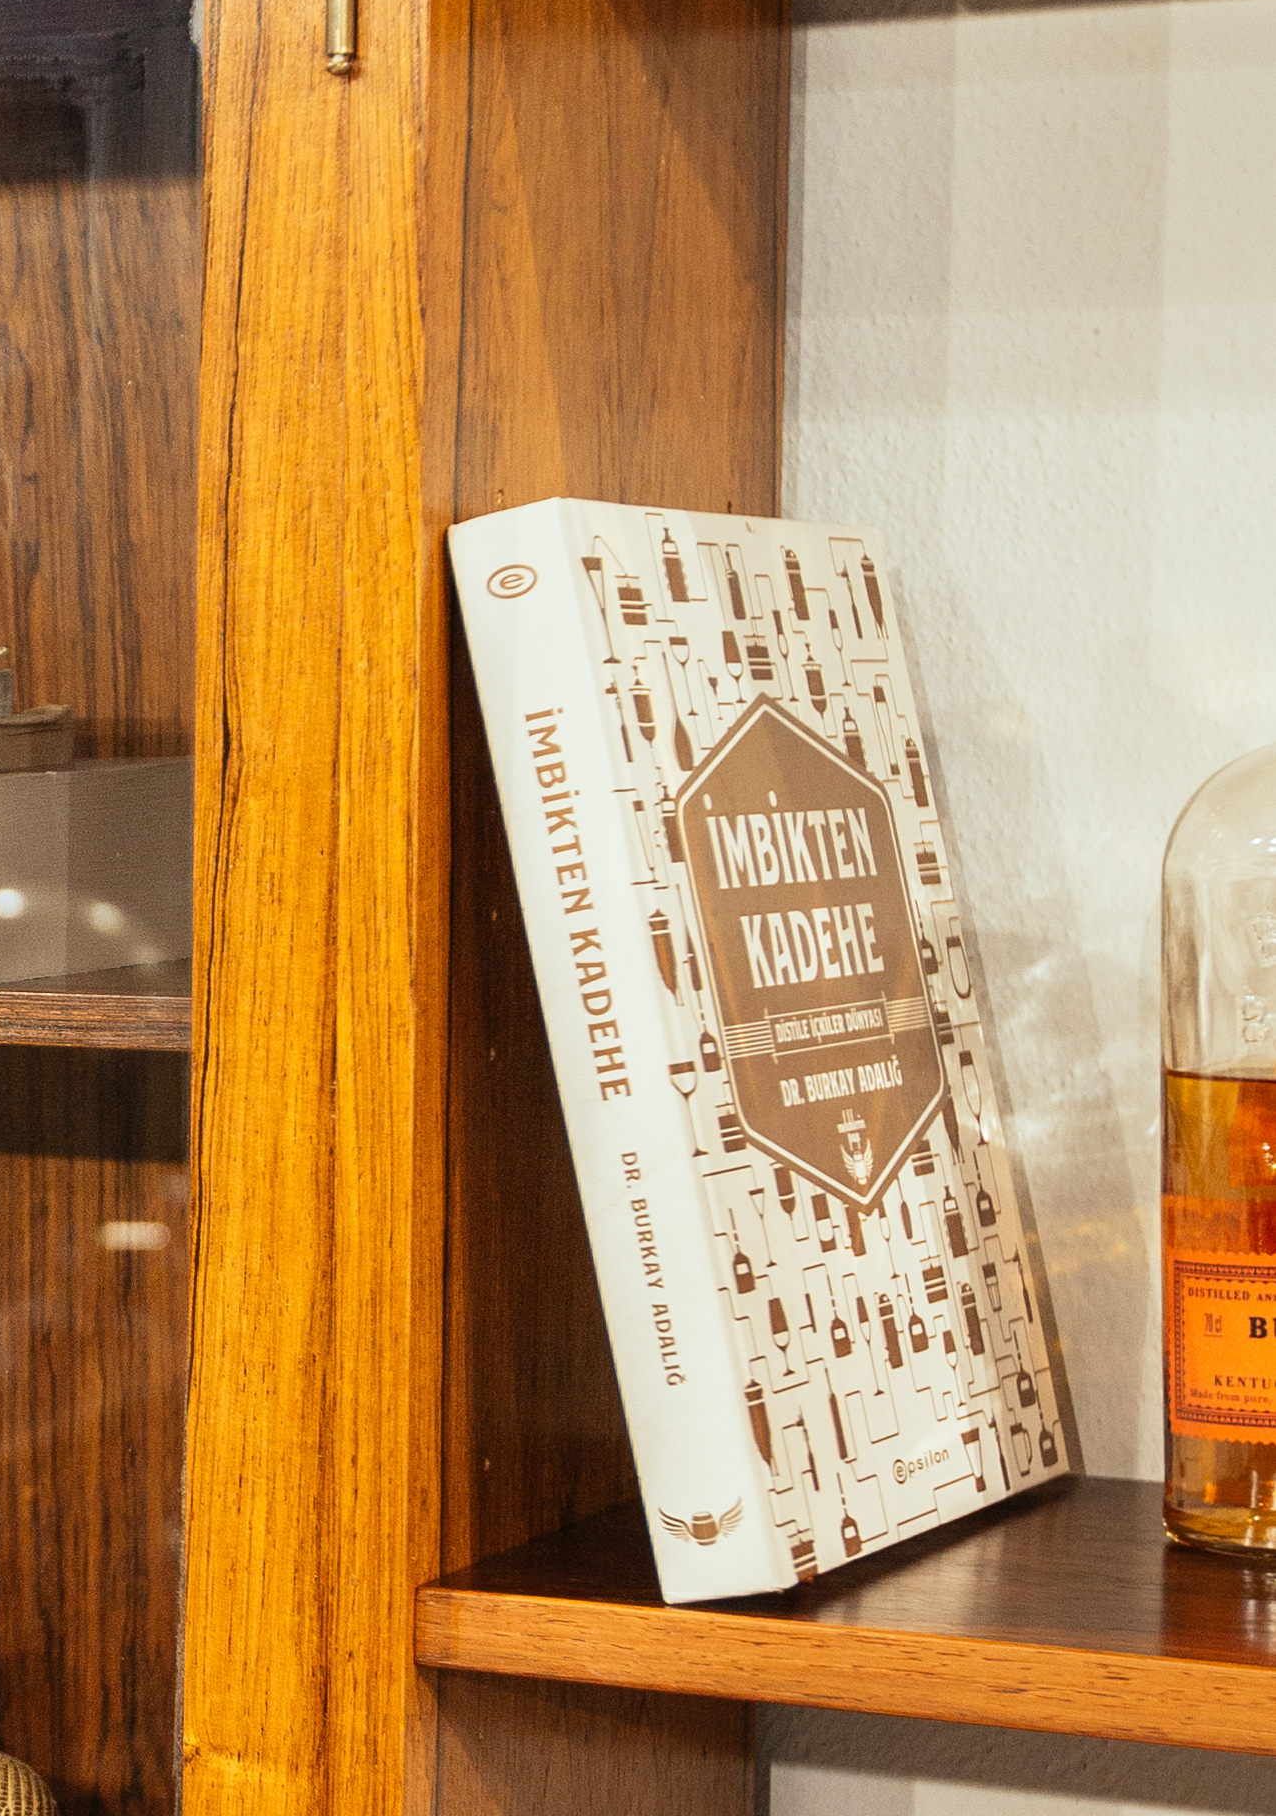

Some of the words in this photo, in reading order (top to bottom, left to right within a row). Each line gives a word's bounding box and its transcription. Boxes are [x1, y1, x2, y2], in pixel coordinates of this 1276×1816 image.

[702, 789, 878, 890] İMBİKTEN
[524, 706, 595, 916] İMBİKTEN
[568, 927, 632, 1102] KADEHE
[739, 902, 885, 989] KADEHE
[779, 1079, 805, 1107] DR.
[804, 1067, 857, 1103] BURKAY
[856, 1054, 904, 1094] ADALIĞ
[621, 1150, 643, 1190] DR.
[630, 1197, 665, 1290] BURKAY
[1187, 1286, 1251, 1302] DISTILLED
[651, 1302, 687, 1387] ADALIĞ
[1248, 1316, 1276, 1339] B
[1214, 1374, 1276, 1390] KENTU
[892, 1448, 951, 1485] epsilon
